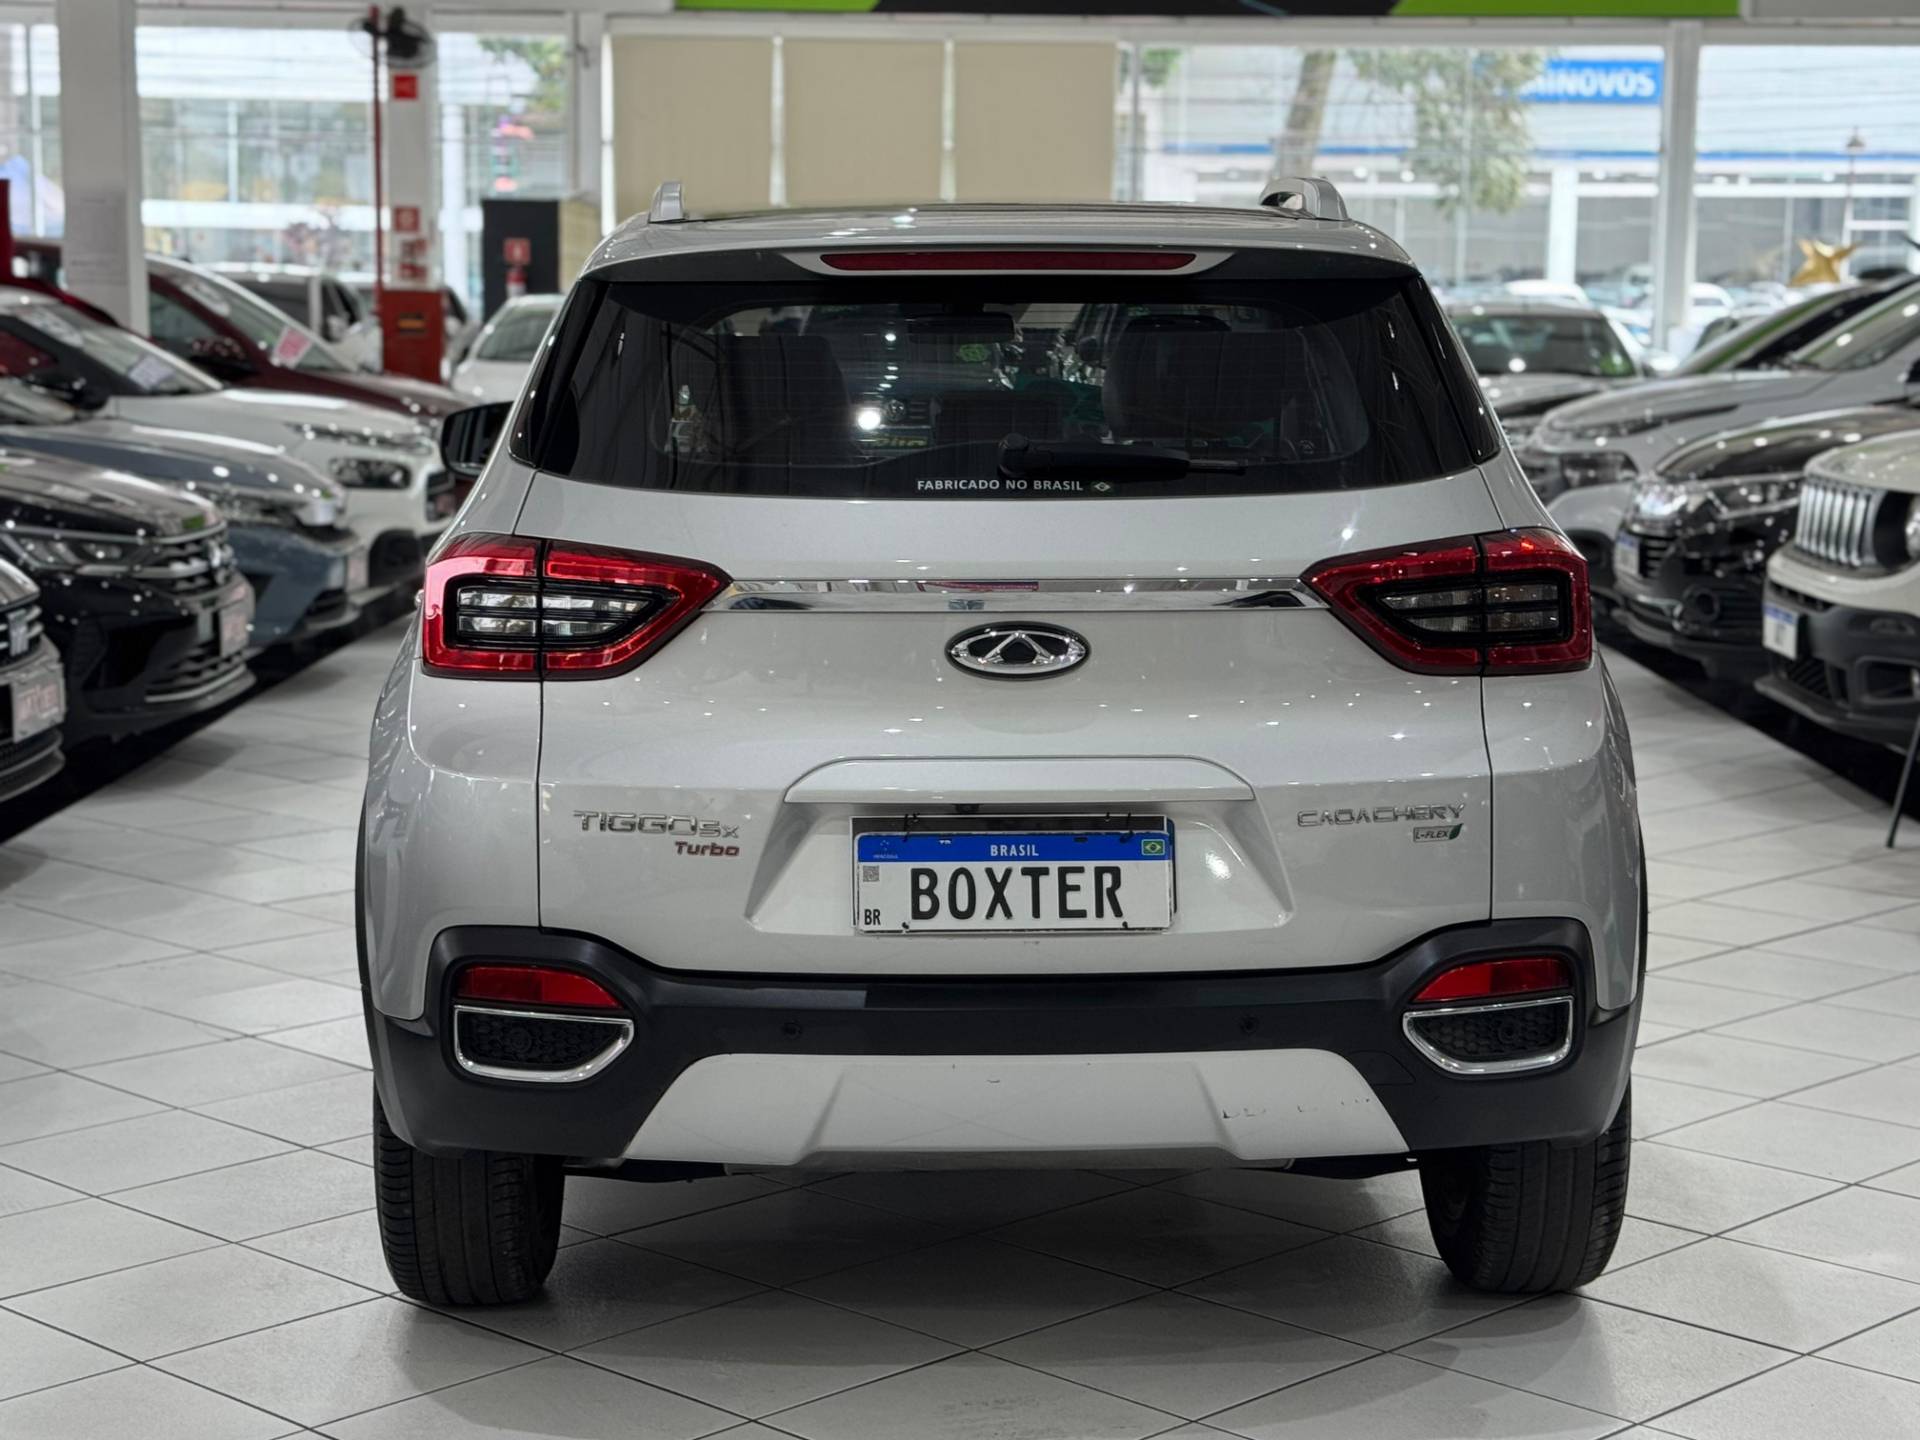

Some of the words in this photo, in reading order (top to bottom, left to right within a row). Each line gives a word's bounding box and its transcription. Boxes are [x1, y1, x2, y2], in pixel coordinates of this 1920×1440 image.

[917, 479, 1000, 490] FABRICADO
[1005, 479, 1028, 490] NO
[1033, 480, 1083, 491] BRASIL
[674, 840, 740, 857] Turbo
[989, 844, 1040, 858] BRASIL
[910, 866, 1124, 921] BOXTER
[863, 908, 882, 927] BR
